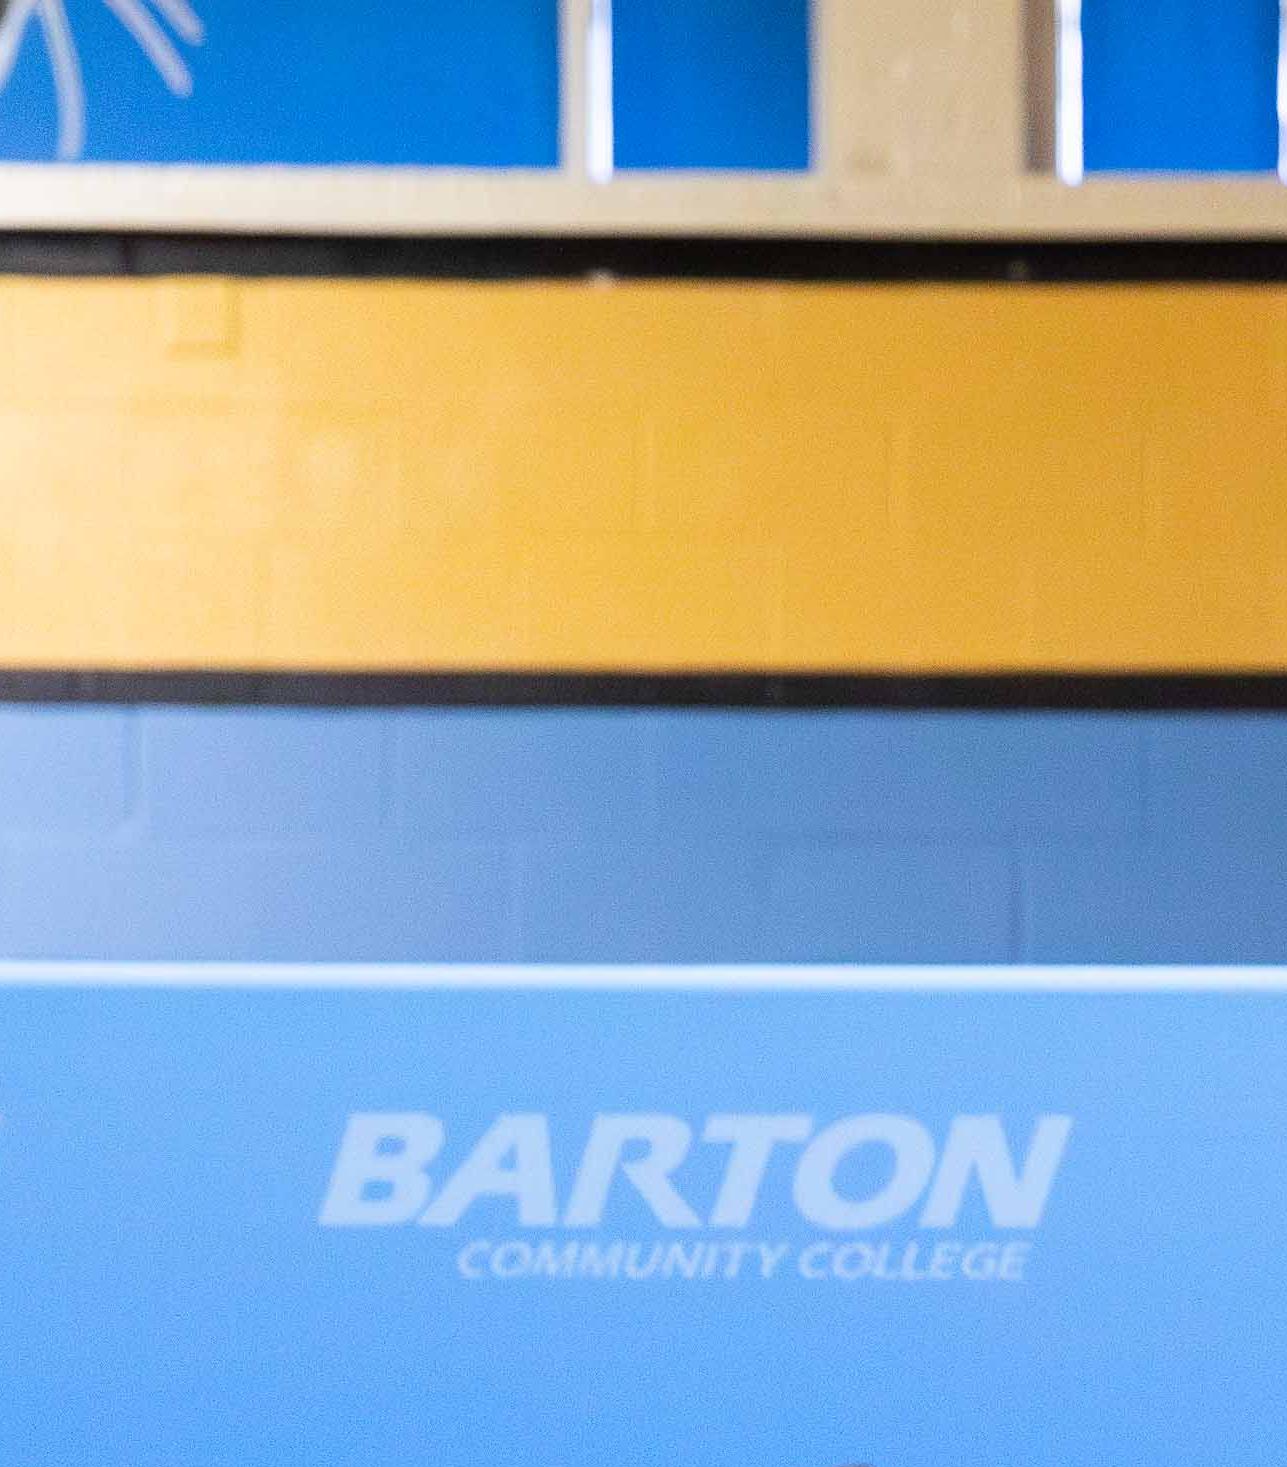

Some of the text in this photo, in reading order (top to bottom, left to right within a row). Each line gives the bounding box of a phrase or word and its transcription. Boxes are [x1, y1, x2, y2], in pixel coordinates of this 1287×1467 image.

[318, 1112, 1073, 1230] BARTON
[457, 1240, 1030, 1282] COMMUNITY COLLEGE
